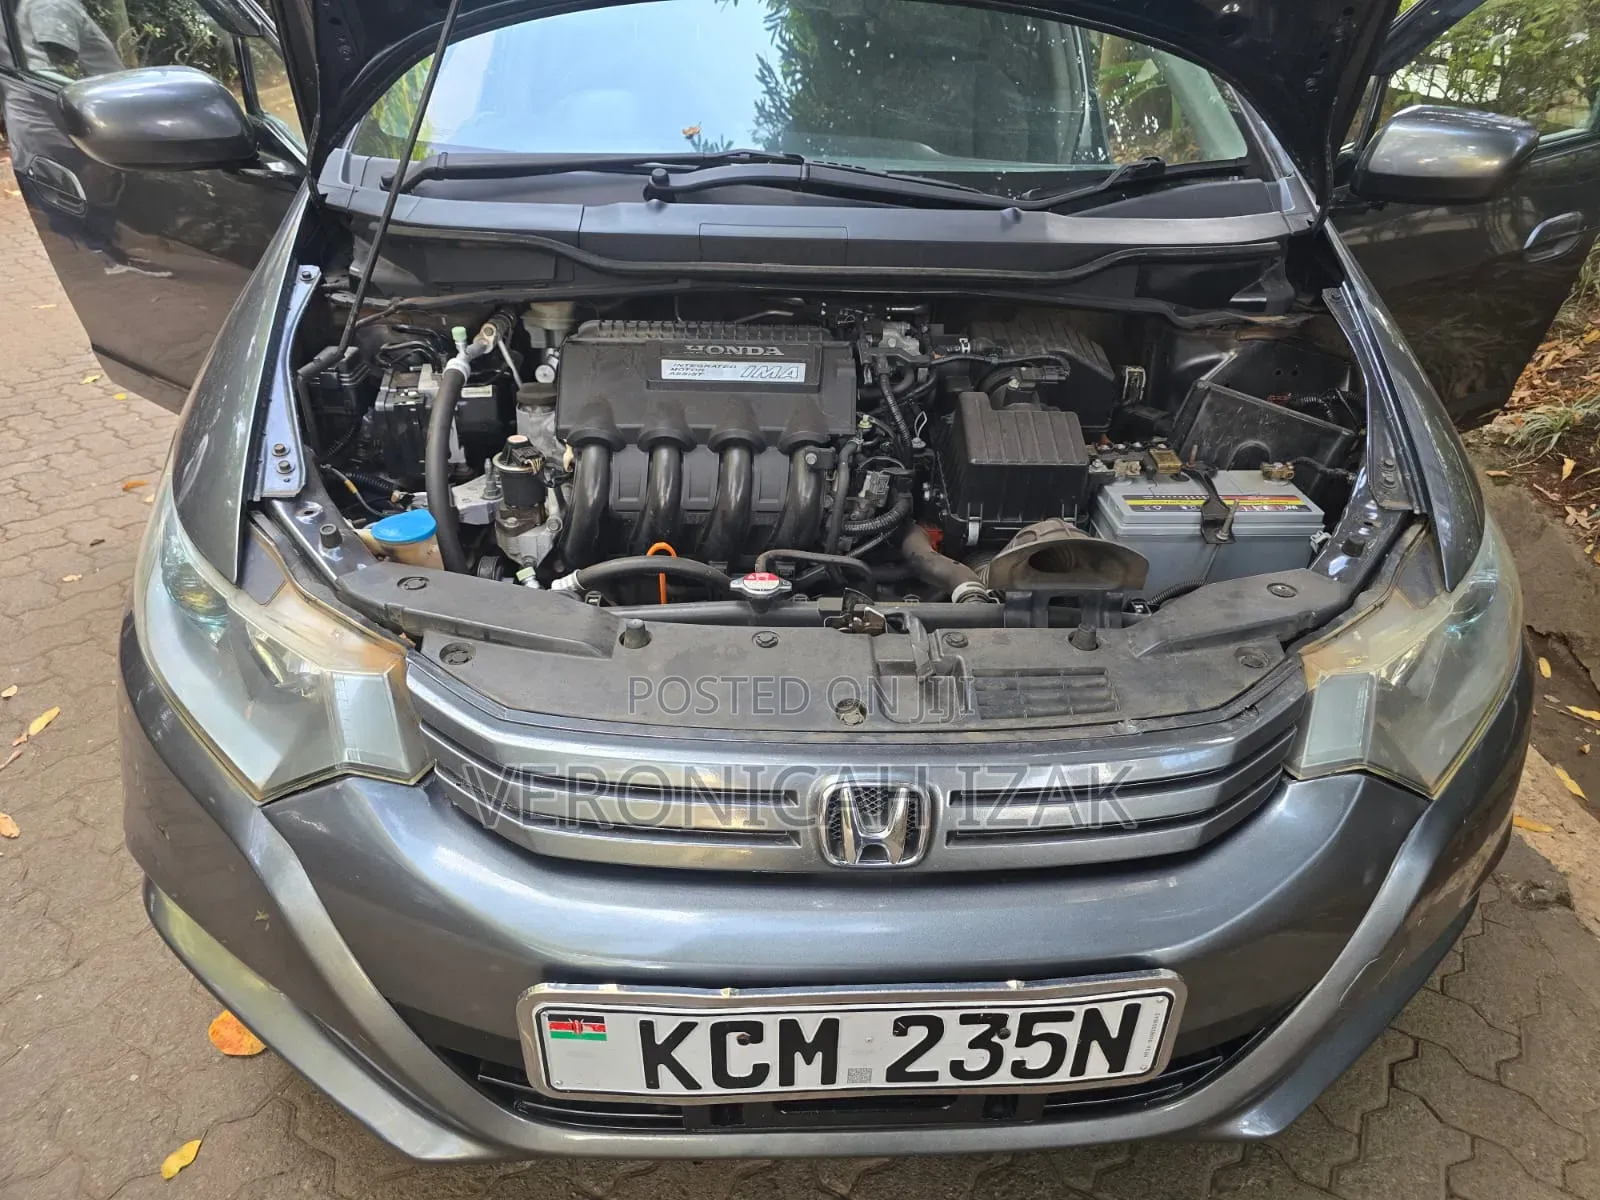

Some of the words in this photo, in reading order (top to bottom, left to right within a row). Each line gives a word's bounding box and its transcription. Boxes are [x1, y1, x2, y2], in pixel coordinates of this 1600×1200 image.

[683, 345, 784, 356] HONDA
[740, 365, 799, 379] IMA
[639, 1017, 840, 1090] KCM
[885, 1002, 1142, 1083] 235N
